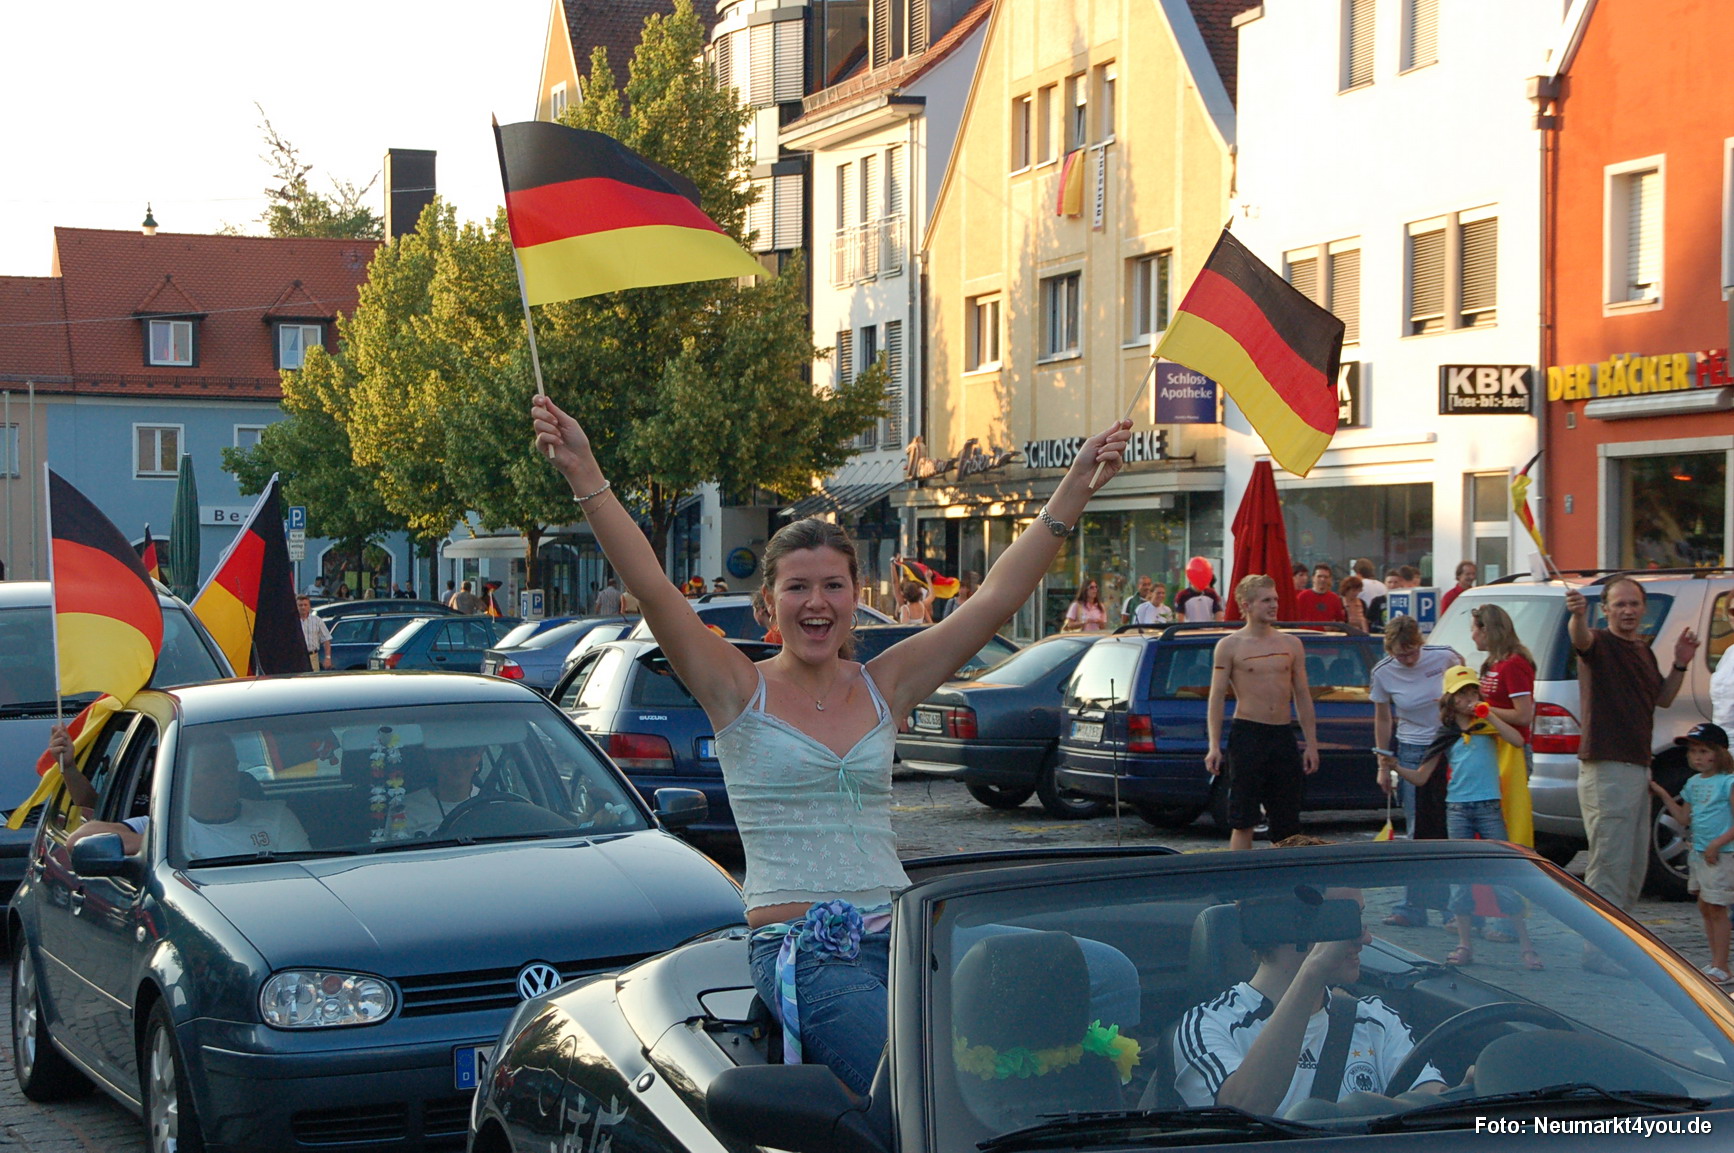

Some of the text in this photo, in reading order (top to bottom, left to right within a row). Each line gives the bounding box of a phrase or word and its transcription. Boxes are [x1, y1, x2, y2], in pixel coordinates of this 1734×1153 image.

[1167, 373, 1207, 385] Schloss
[1448, 367, 1529, 395] KBK
[1547, 364, 1592, 402] DER
[1597, 352, 1691, 397] BÄCKER
[1160, 387, 1213, 400] Apotheke
[292, 508, 302, 528] P
[1421, 597, 1433, 617] P
[250, 831, 270, 847] 13
[462, 1071, 471, 1082] D
